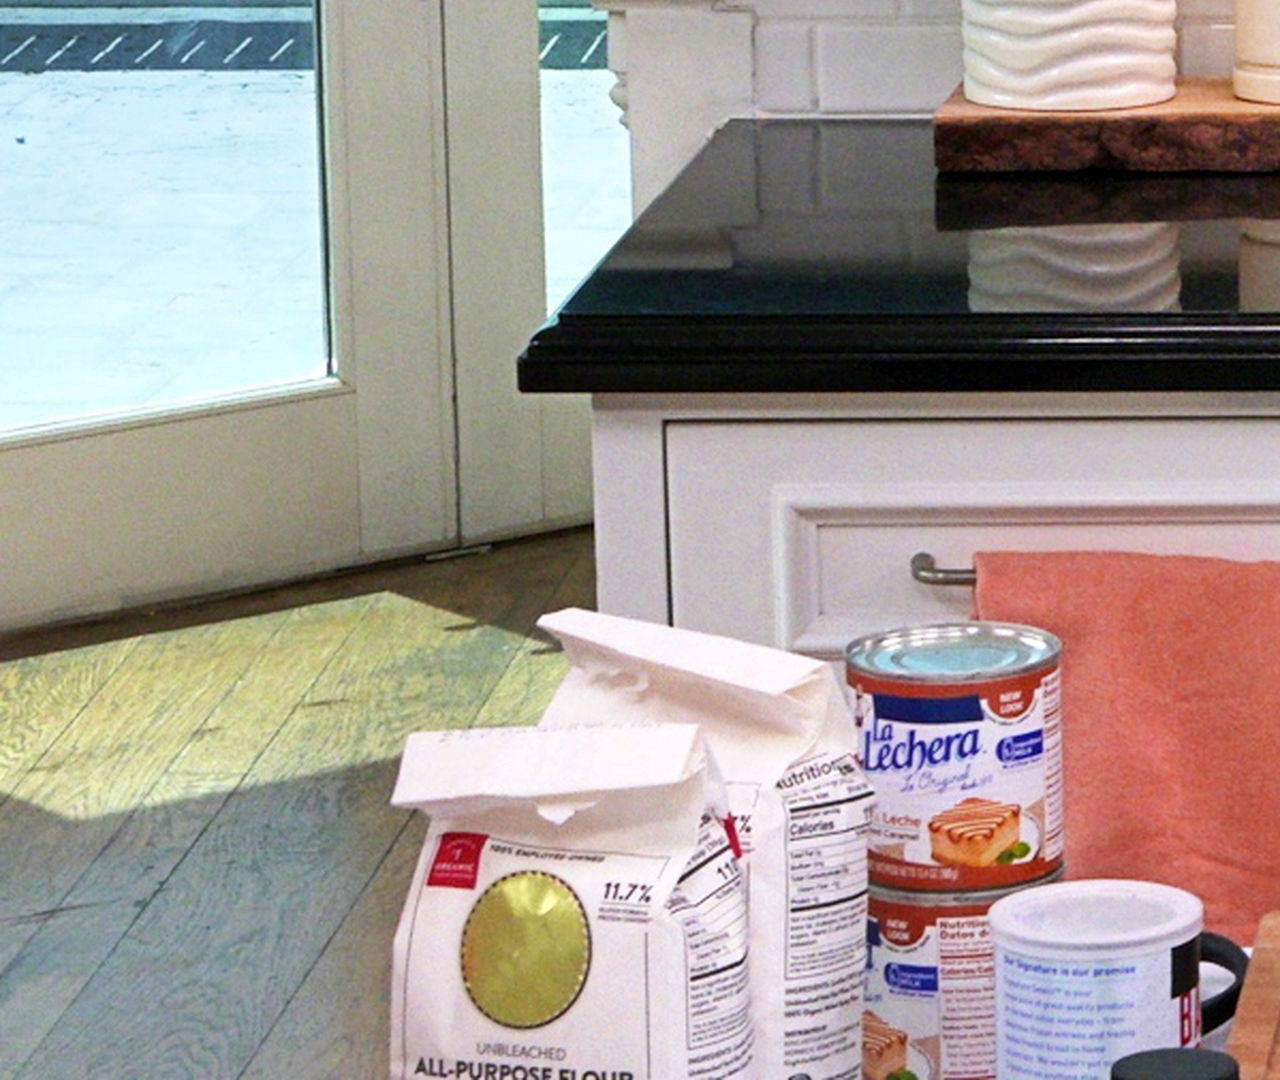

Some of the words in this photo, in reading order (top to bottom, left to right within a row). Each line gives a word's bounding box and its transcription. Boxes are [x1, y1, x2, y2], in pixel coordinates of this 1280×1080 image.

[873, 718, 893, 741] La
[865, 729, 981, 775] Lechera
[790, 821, 835, 836] Calories
[604, 882, 654, 903] 11.7%
[1092, 966, 1136, 978] promise
[476, 1042, 567, 1062] UNBLEACHED
[414, 1057, 553, 1080] ALL-PURPOSE
